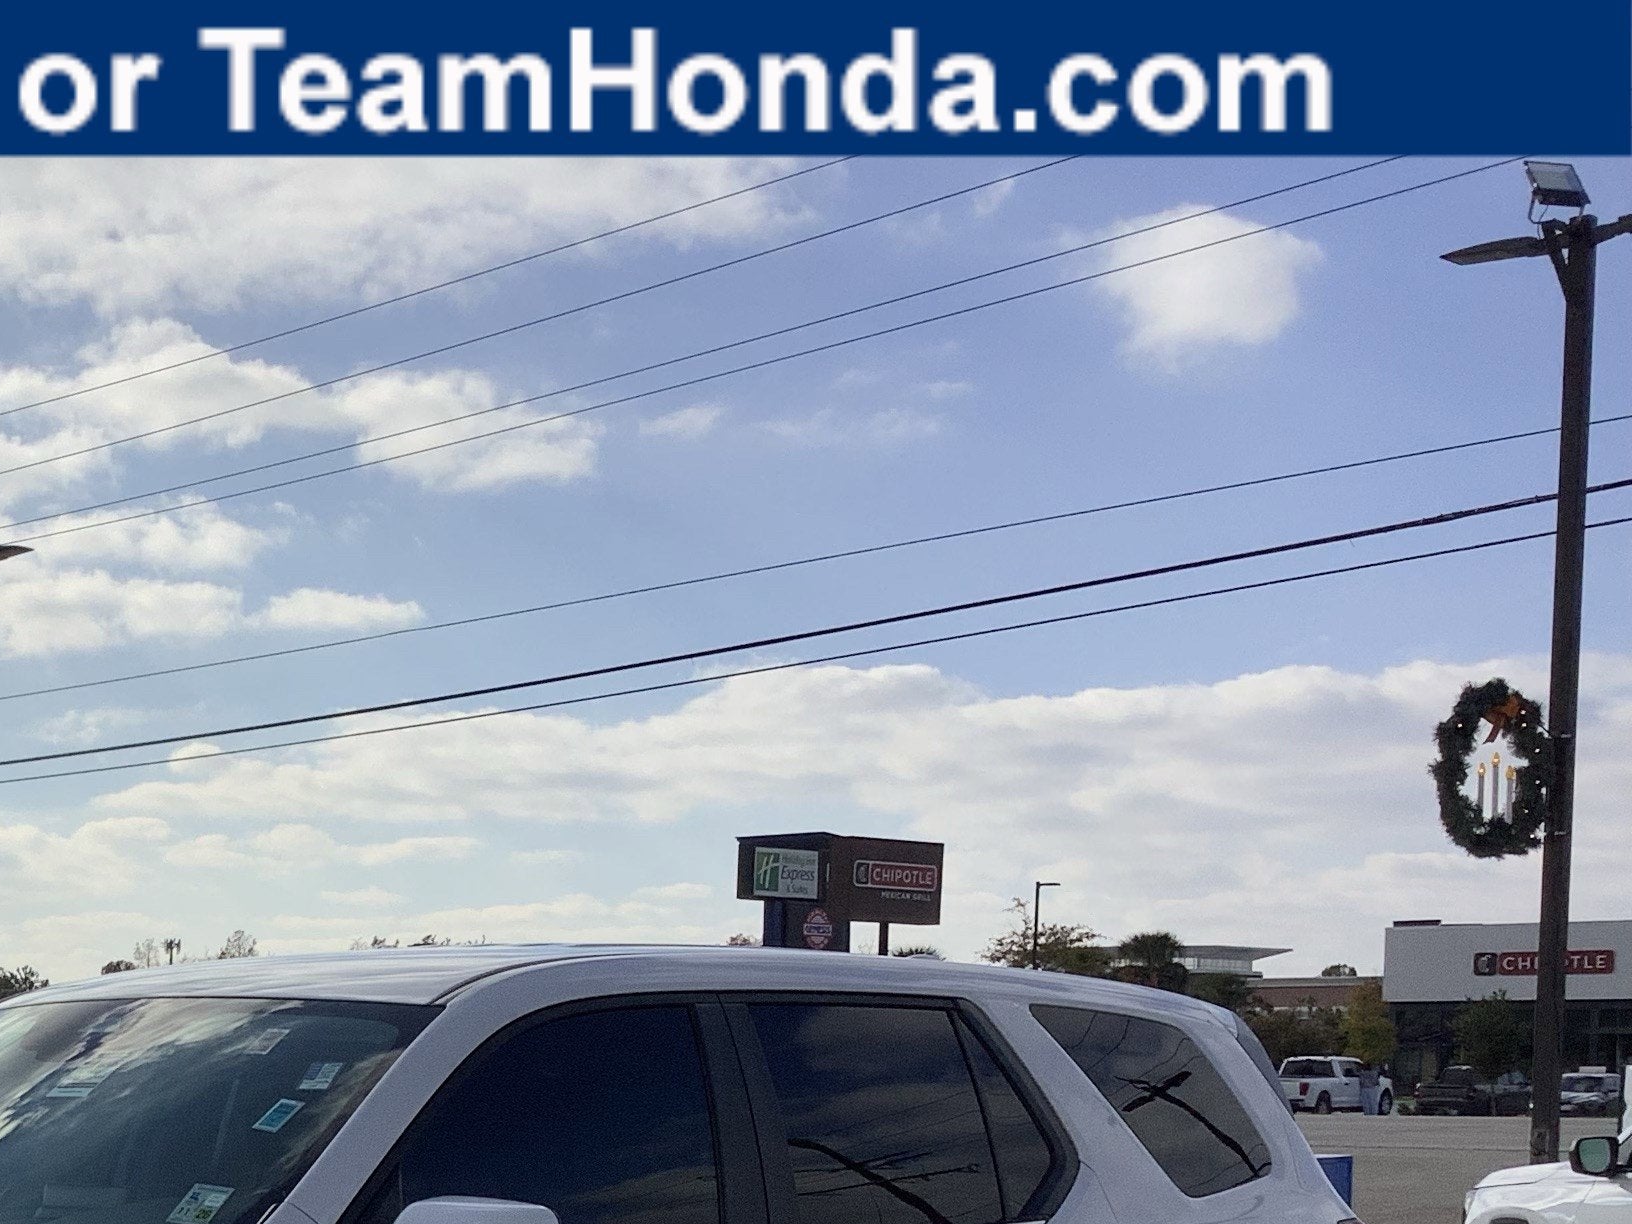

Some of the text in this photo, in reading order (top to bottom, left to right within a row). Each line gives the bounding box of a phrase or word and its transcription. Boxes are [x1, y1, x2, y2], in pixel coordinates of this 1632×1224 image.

[780, 865, 815, 884] Express
[872, 867, 934, 885] CHIPOTLE
[1502, 954, 1608, 971] CHITLE
